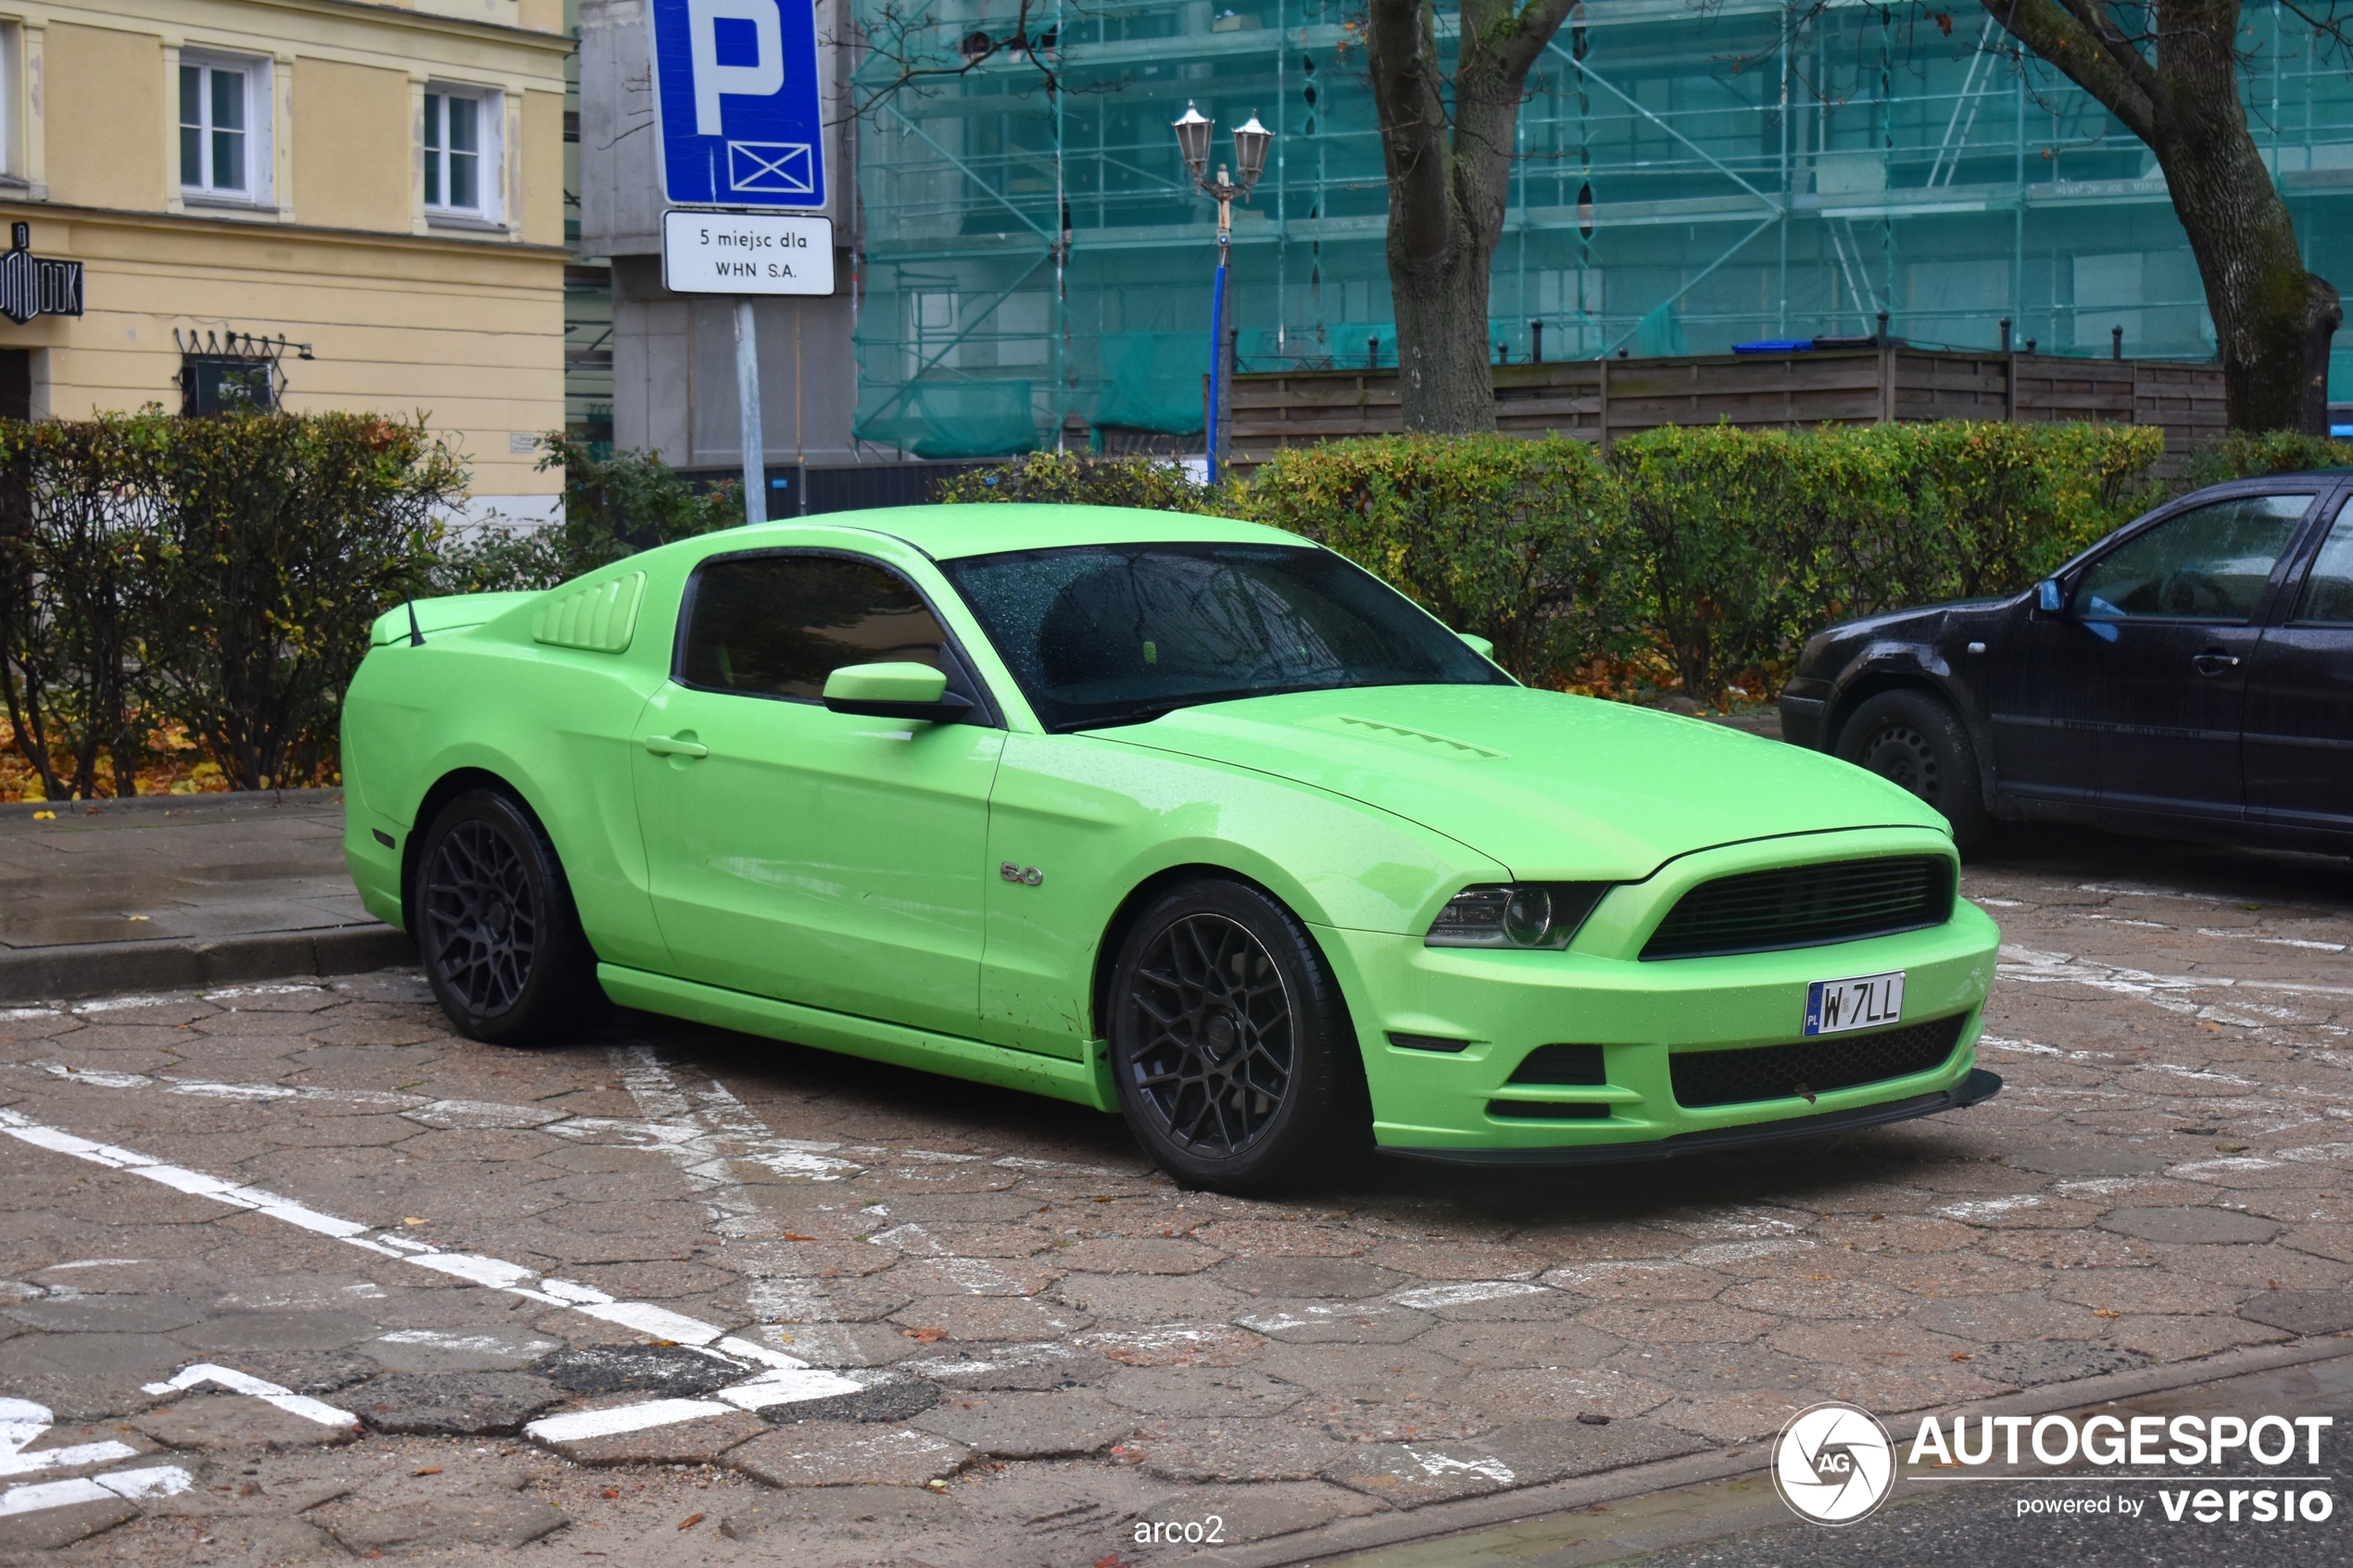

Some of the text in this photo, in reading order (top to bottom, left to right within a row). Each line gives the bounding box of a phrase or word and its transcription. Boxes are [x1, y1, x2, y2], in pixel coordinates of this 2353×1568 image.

[688, 0, 785, 136] P
[700, 229, 808, 251] 5 miejsc dla
[715, 262, 798, 278] WHN S.A.
[1000, 861, 1043, 885] 5.0
[1807, 979, 1898, 1028] PL W 7LL
